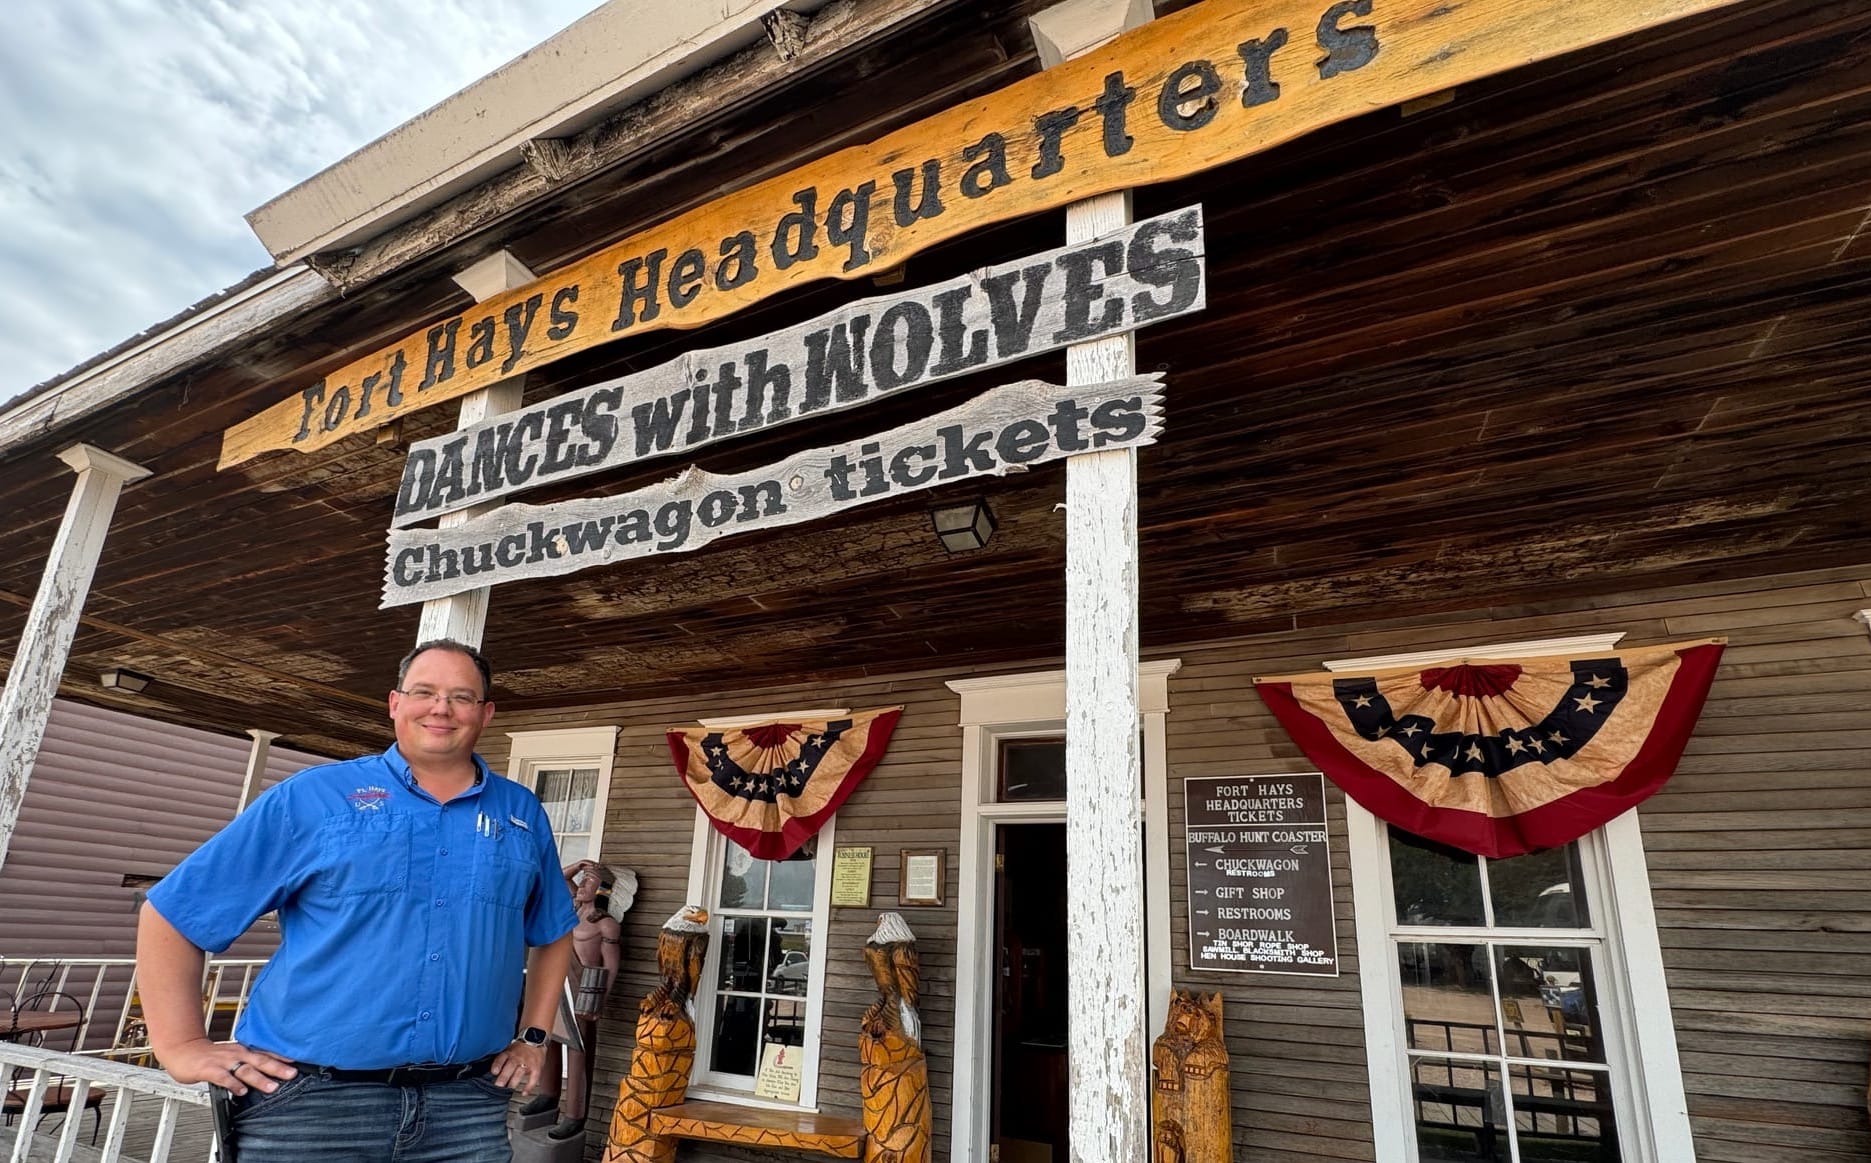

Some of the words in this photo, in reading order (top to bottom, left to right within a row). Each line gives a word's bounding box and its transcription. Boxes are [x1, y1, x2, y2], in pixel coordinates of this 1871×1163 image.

[292, 347, 406, 443] Fort
[418, 284, 580, 392] Hays
[612, 0, 1380, 333] Headquarters
[395, 386, 625, 517] DANCES
[631, 349, 792, 457] with
[798, 208, 1202, 412] WOLVES
[392, 478, 787, 587] Chuckwagon
[824, 396, 1147, 501] tickets
[1216, 785, 1248, 797] FORT
[1258, 783, 1294, 796] HAYS
[1206, 798, 1304, 811] HEADQUARTERS
[1228, 811, 1284, 823] TICKETS
[1188, 832, 1236, 844] BUFFALO
[1239, 832, 1270, 843] HUNT
[1272, 831, 1327, 843] COASTER
[1215, 859, 1299, 871] CHUCKWAGON
[1226, 869, 1275, 877] RESTROOMS
[1216, 887, 1244, 899] GIFT
[1252, 887, 1285, 900] SHOP
[1217, 907, 1292, 920] RESTROOMS
[1218, 928, 1295, 942] BOARDWALK
[1212, 939, 1228, 947] TIN
[1259, 941, 1282, 949] ROPE
[1200, 952, 1217, 960] HEN
[1220, 953, 1247, 961] HOUSE
[1250, 954, 1293, 963] SHOOTING
[1296, 956, 1334, 965] GALLERY
[1243, 947, 1296, 956] BLACKSMITH
[1301, 950, 1325, 958] SHOP
